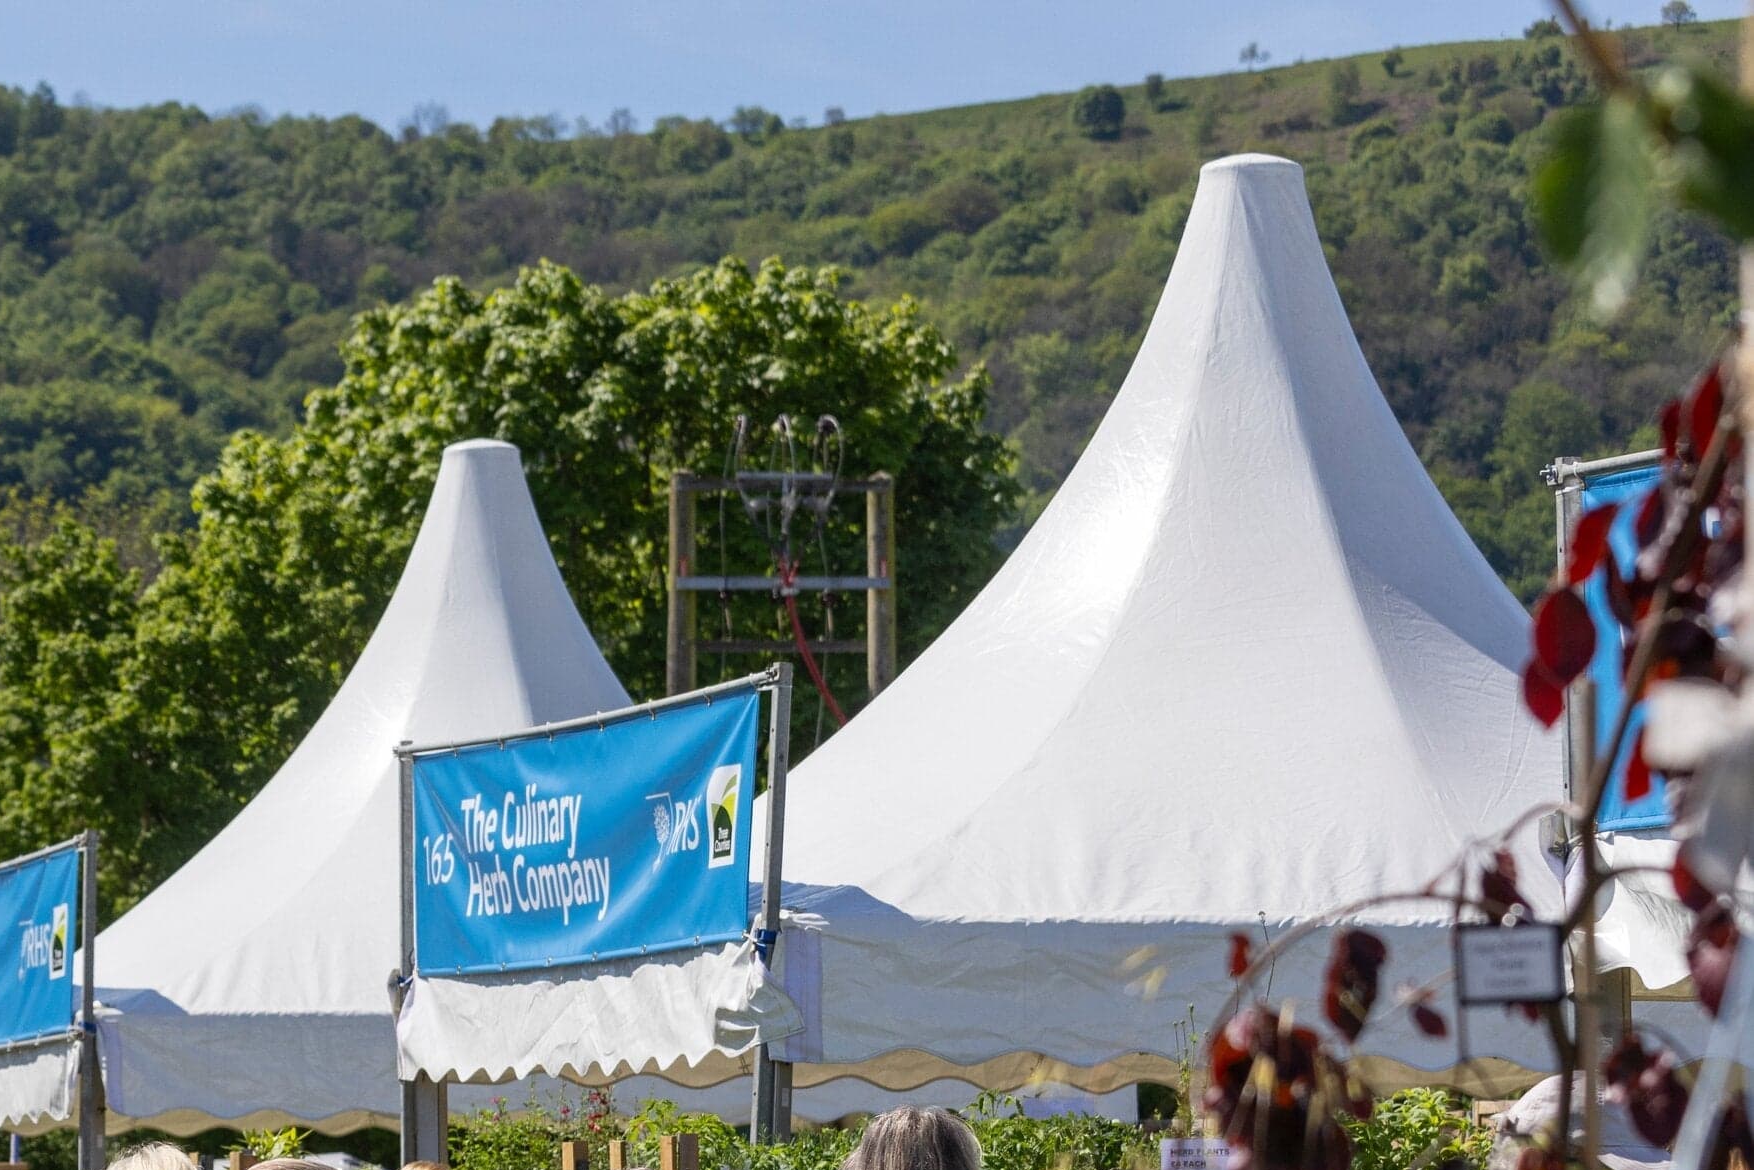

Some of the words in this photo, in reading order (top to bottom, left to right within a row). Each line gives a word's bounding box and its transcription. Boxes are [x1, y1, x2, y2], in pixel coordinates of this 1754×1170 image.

[460, 793, 498, 854] The
[502, 783, 582, 859] Culinary
[423, 832, 455, 886] 165
[465, 854, 512, 917] Herb
[513, 854, 610, 926] Company
